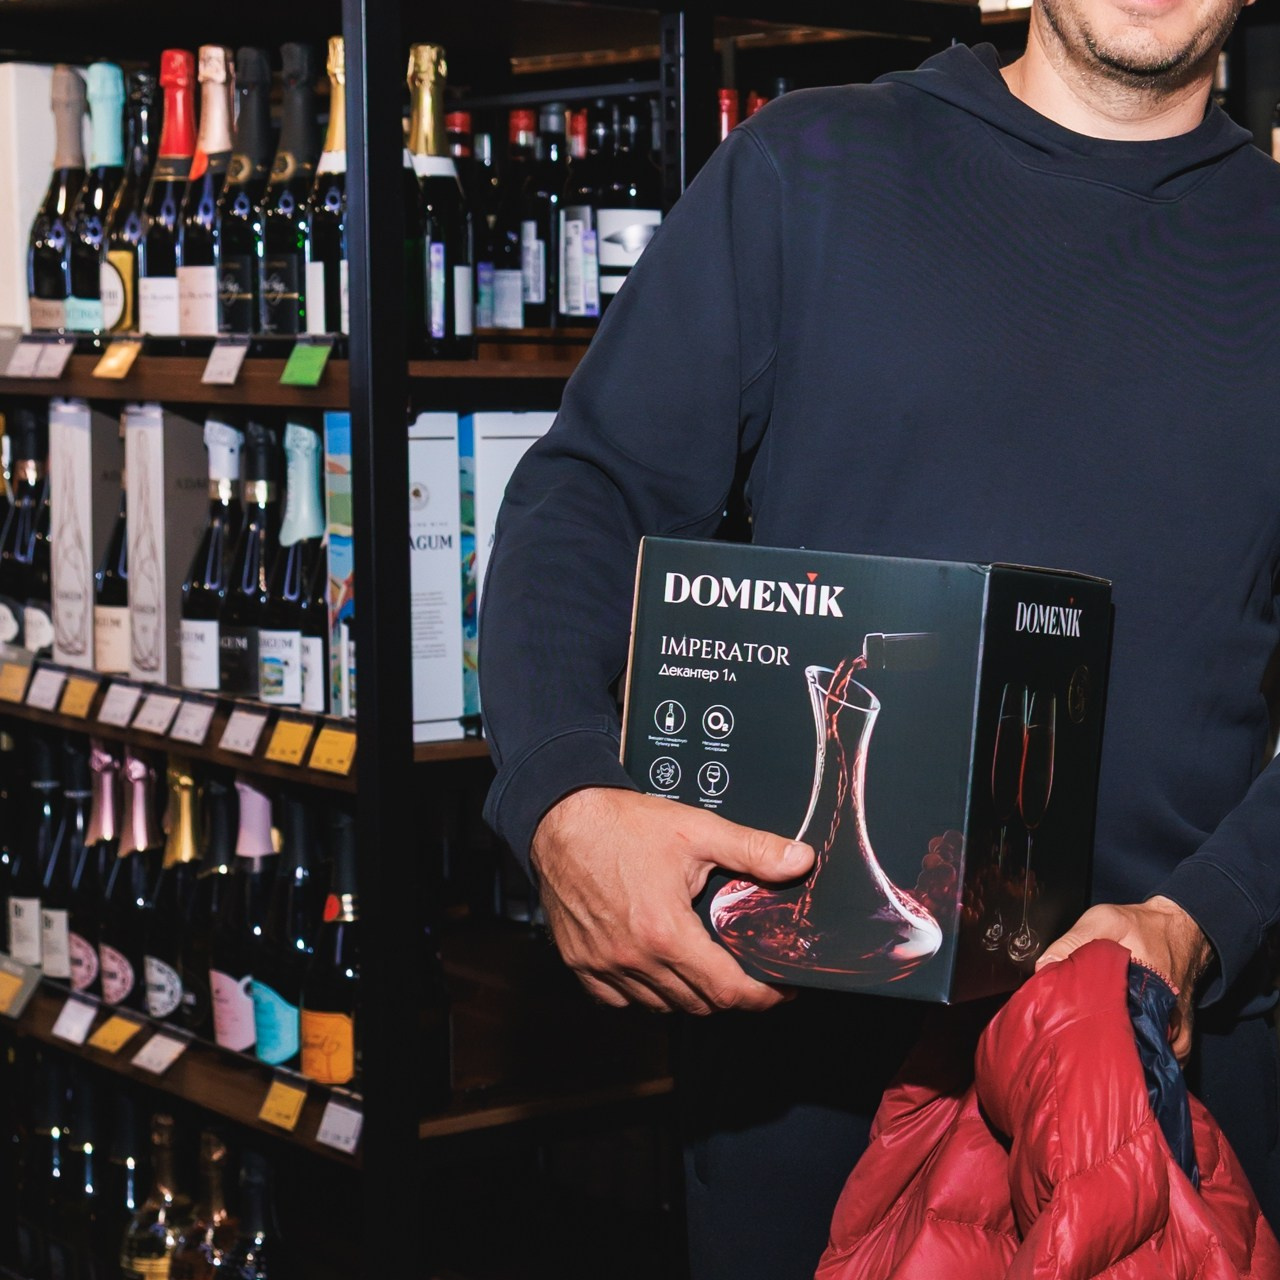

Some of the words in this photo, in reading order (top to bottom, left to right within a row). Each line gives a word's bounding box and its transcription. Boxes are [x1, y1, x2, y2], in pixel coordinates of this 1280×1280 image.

[660, 634, 791, 666] IMPERATOR
[658, 663, 719, 683] Декантер
[722, 667, 737, 682] 1л
